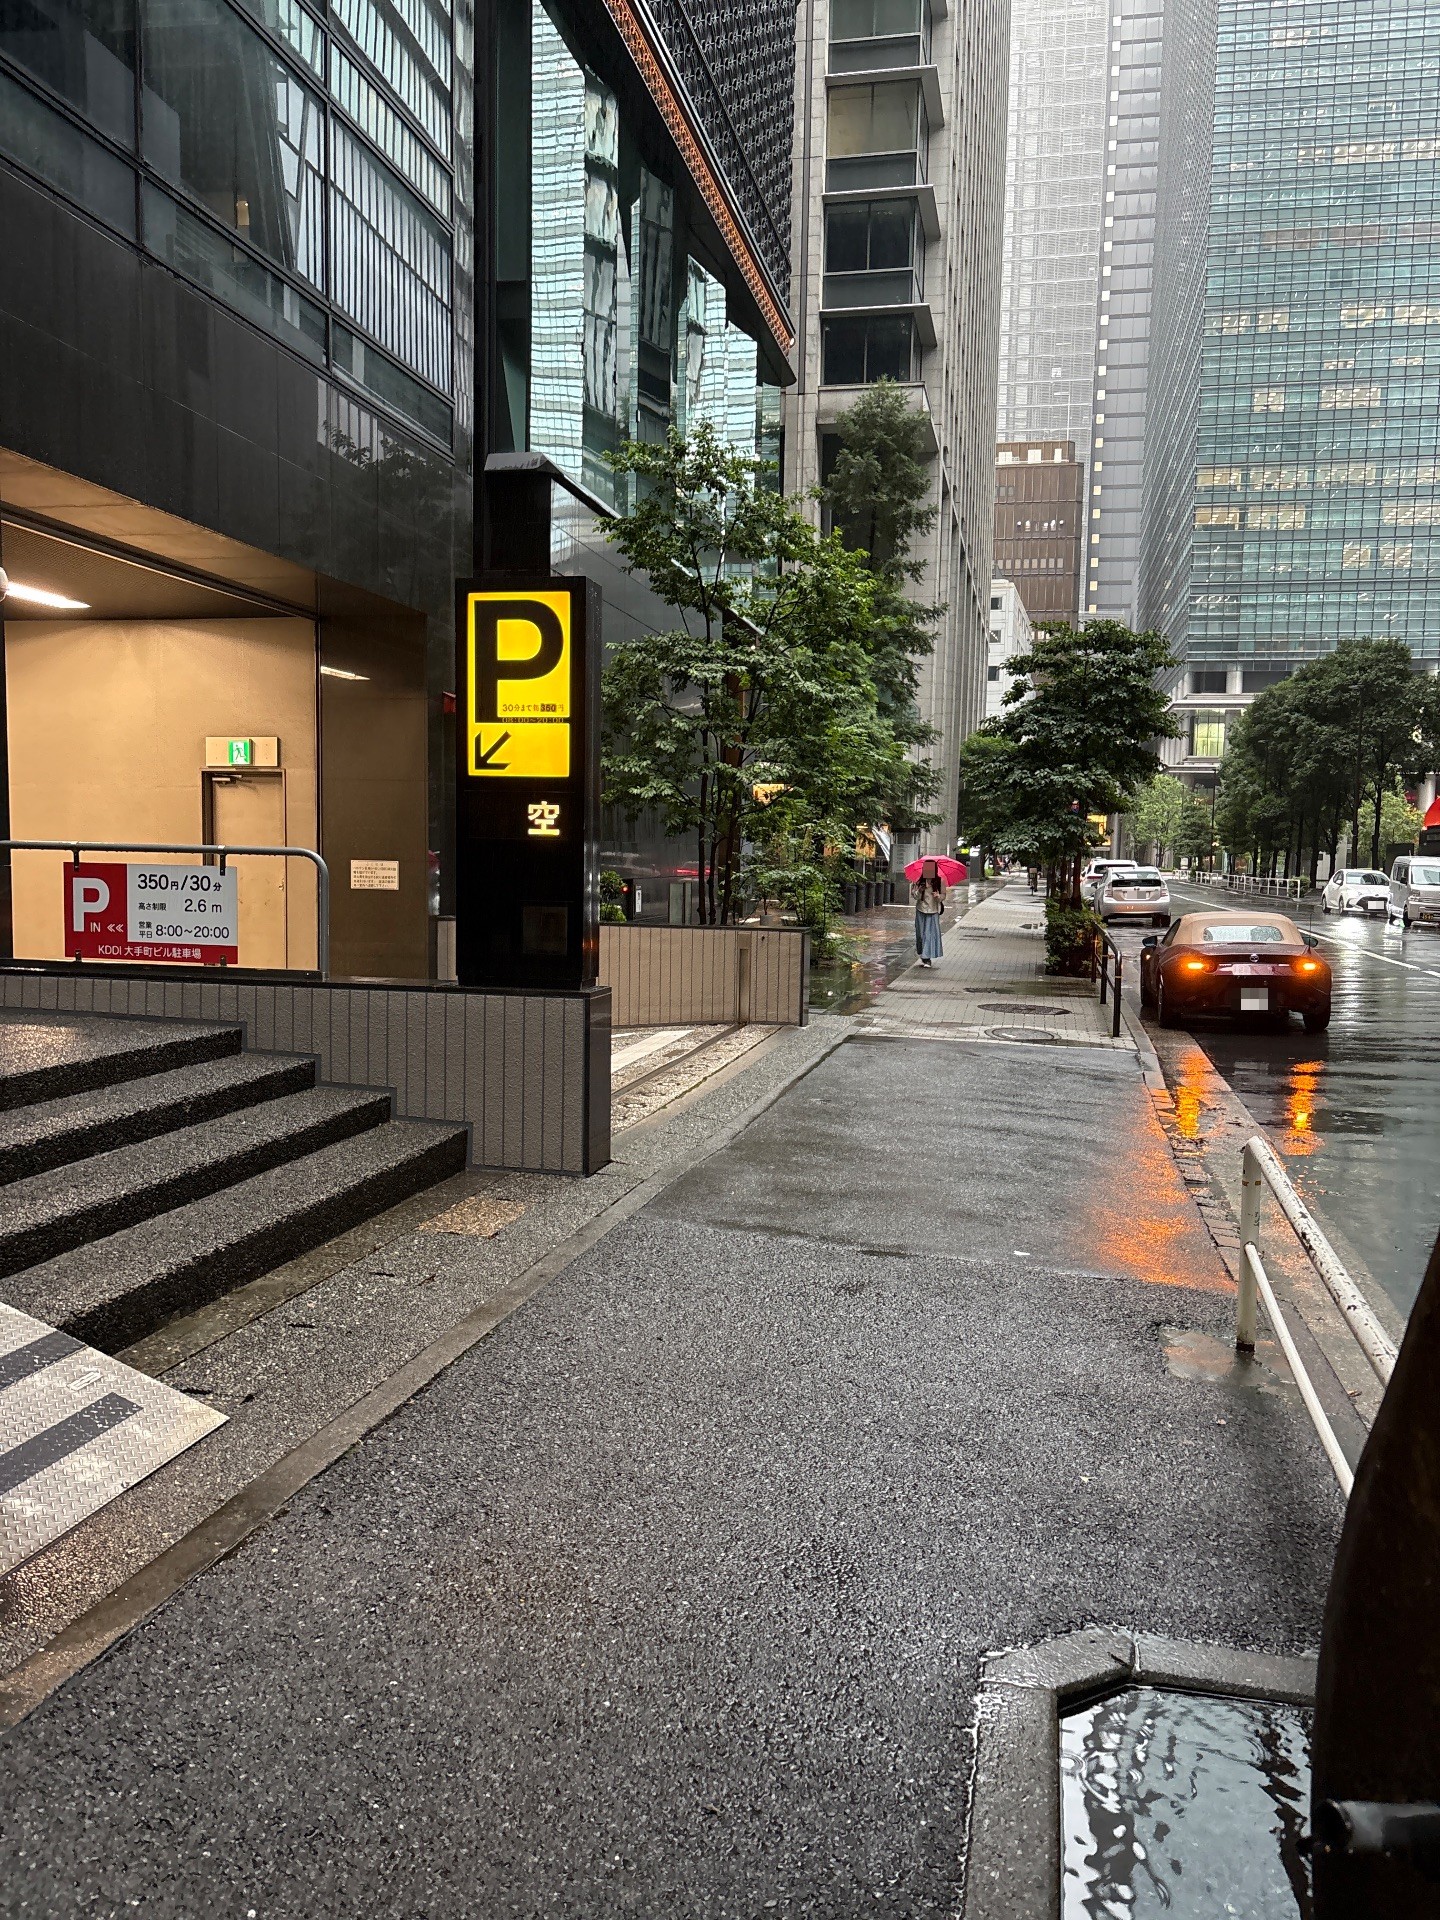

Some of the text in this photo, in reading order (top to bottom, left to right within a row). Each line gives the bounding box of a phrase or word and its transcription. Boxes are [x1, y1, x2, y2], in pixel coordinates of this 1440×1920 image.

[474, 599, 564, 723] P
[528, 801, 560, 835] 空
[73, 877, 110, 932] P
[138, 899, 222, 913] 高さ制限 2.6 m
[90, 922, 101, 933] IN
[138, 921, 153, 929] 営業
[138, 930, 153, 939] 平日
[98, 945, 202, 959] KDDI 大手町ビル駐車場
